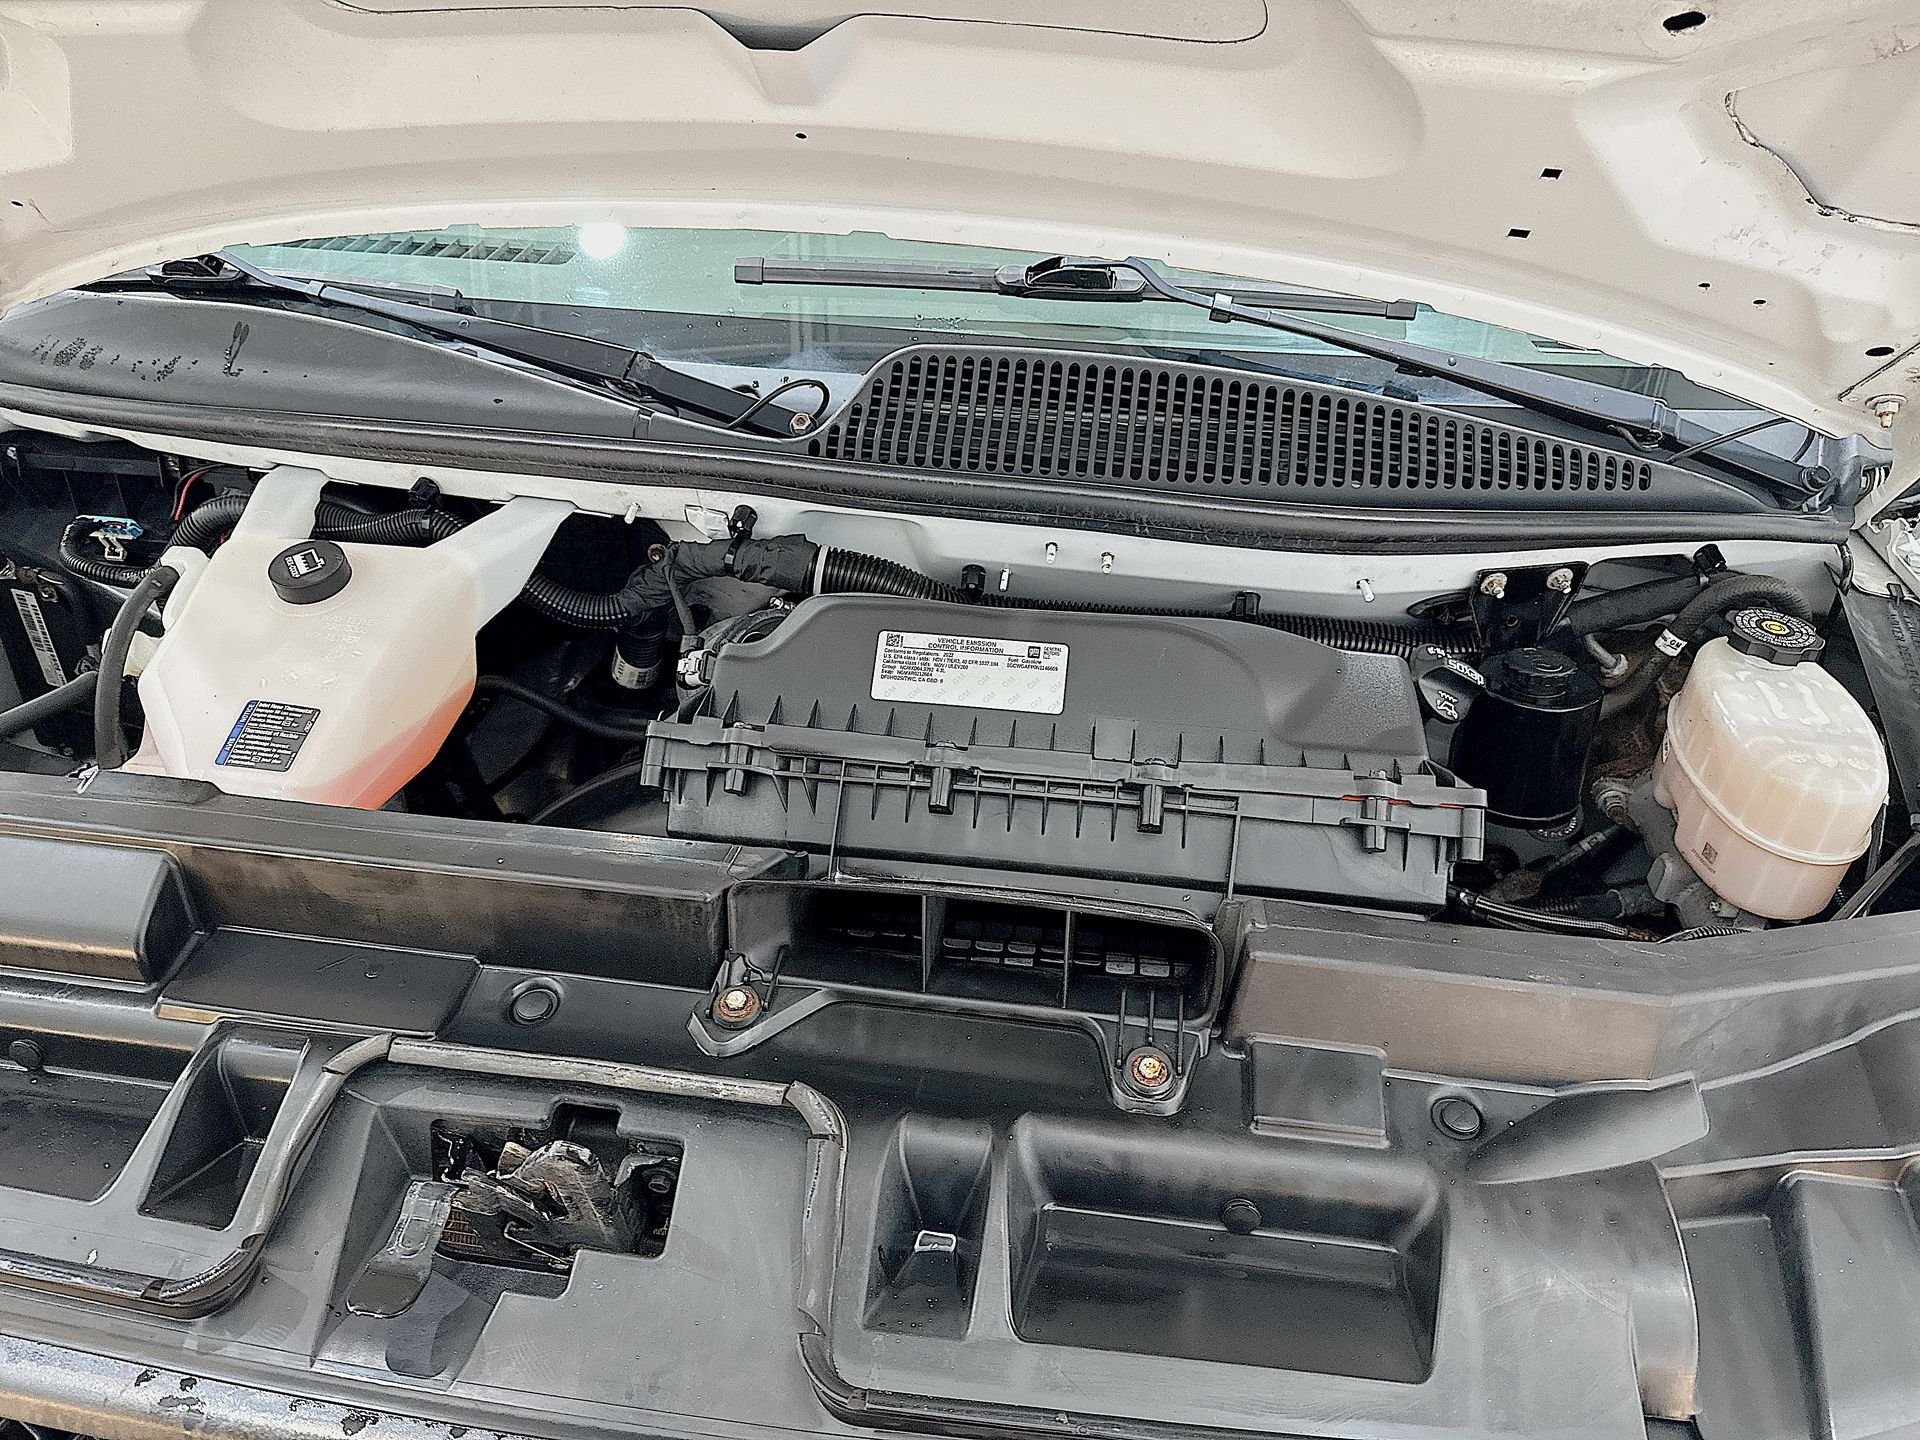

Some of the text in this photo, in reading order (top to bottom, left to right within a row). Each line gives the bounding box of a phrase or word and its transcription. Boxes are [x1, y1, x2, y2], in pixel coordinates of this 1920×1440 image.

[960, 645, 1004, 653] INFORMATION
[1448, 659, 1484, 685] dexos
[242, 704, 255, 723] NOTICE
[224, 737, 236, 750] AVIS
